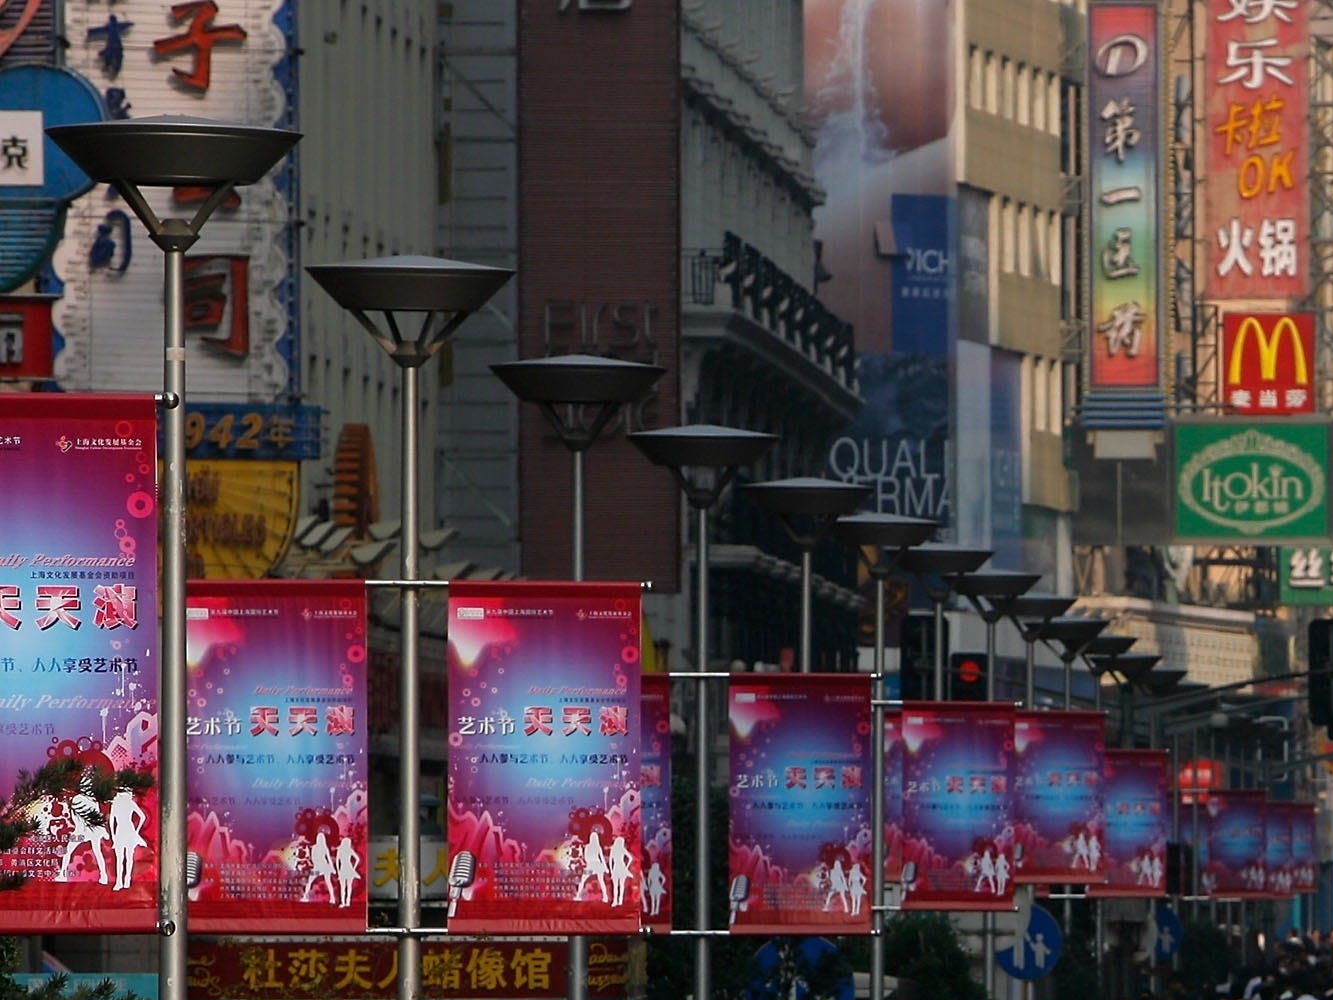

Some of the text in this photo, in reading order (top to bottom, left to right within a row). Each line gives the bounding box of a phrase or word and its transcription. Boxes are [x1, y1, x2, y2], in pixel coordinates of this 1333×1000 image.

[1214, 94, 1285, 157] 卡拉
[1237, 151, 1297, 199] OK
[1216, 217, 1298, 278] 火锅
[1232, 388, 1307, 409] 麦当劳
[30, 553, 136, 567] Performance
[457, 717, 516, 736] 艺术节
